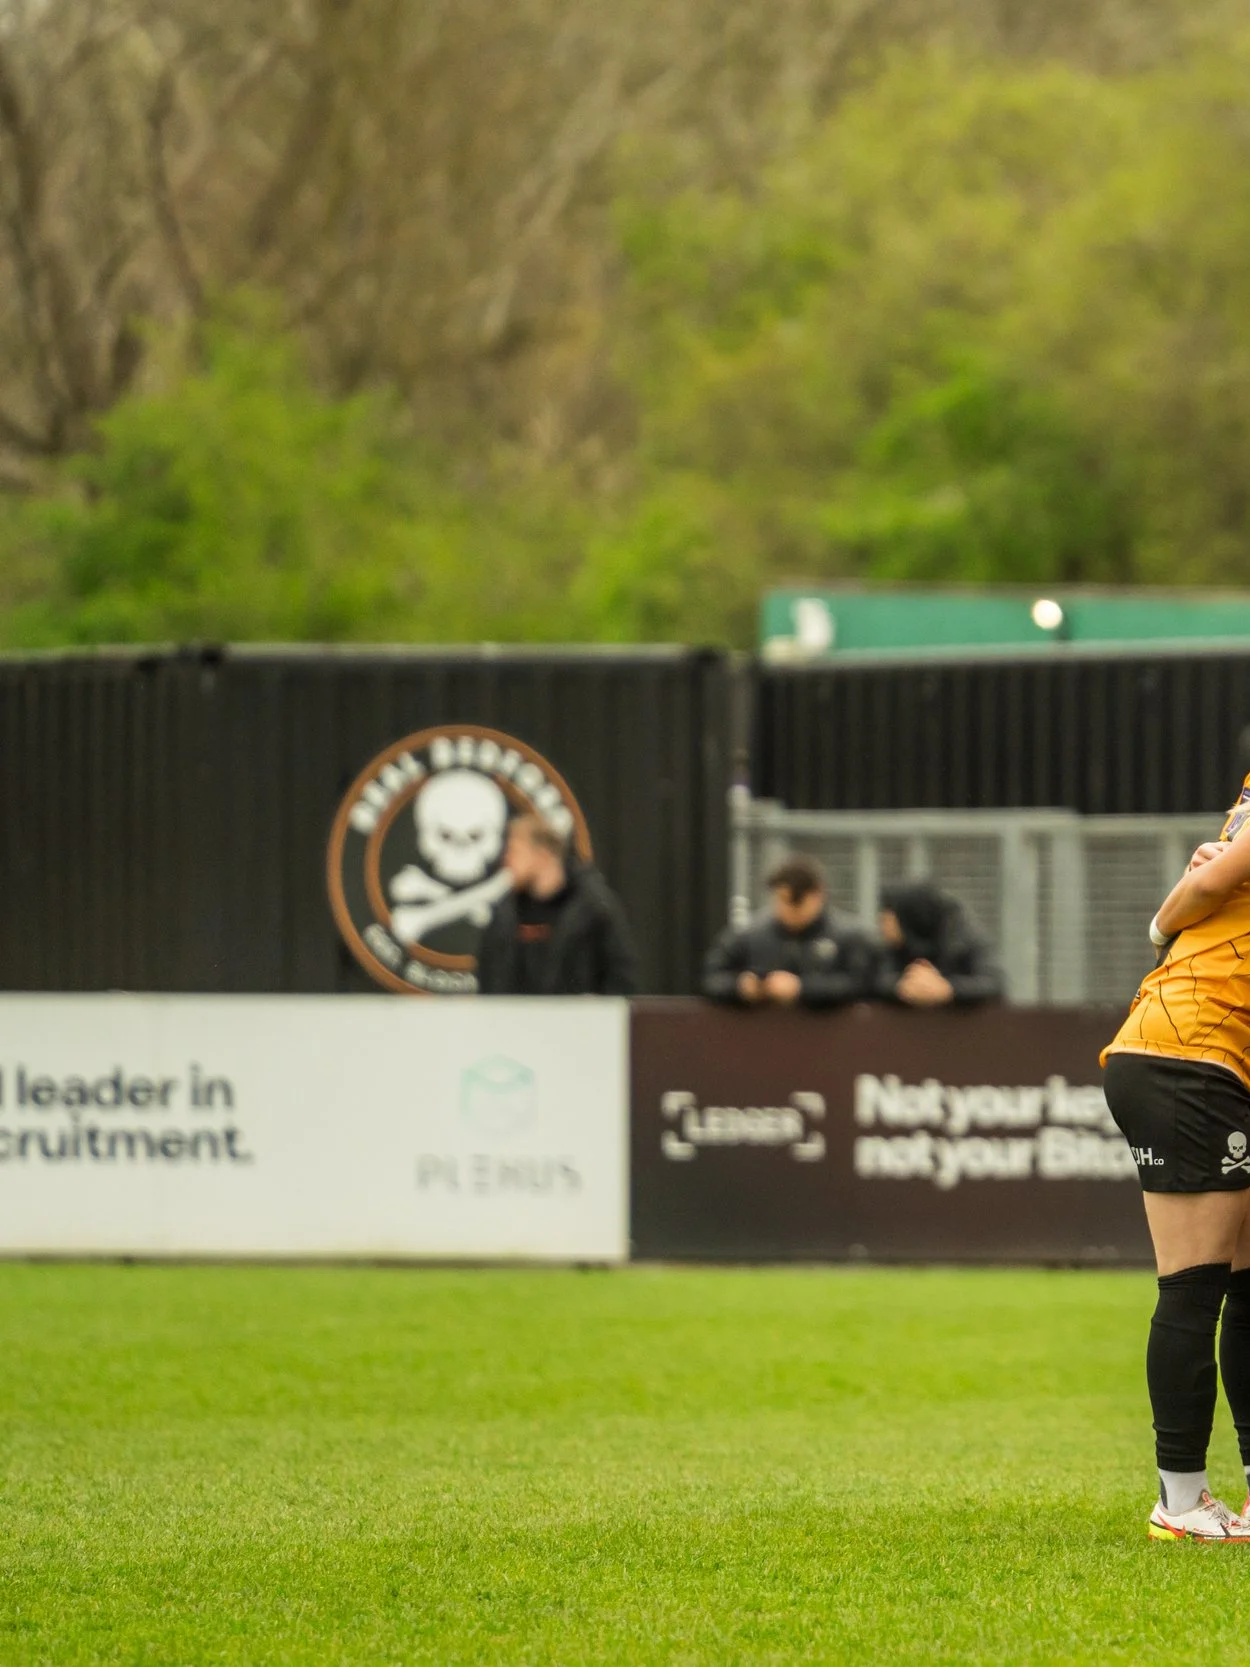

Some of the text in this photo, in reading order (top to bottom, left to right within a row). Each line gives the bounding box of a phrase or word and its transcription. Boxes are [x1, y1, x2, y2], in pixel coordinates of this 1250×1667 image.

[16, 1060, 178, 1109] leader
[189, 1060, 234, 1109] in
[854, 1074, 944, 1128] Not
[943, 1084, 1044, 1135] your
[854, 1130, 934, 1180] not
[931, 1135, 1035, 1191] your
